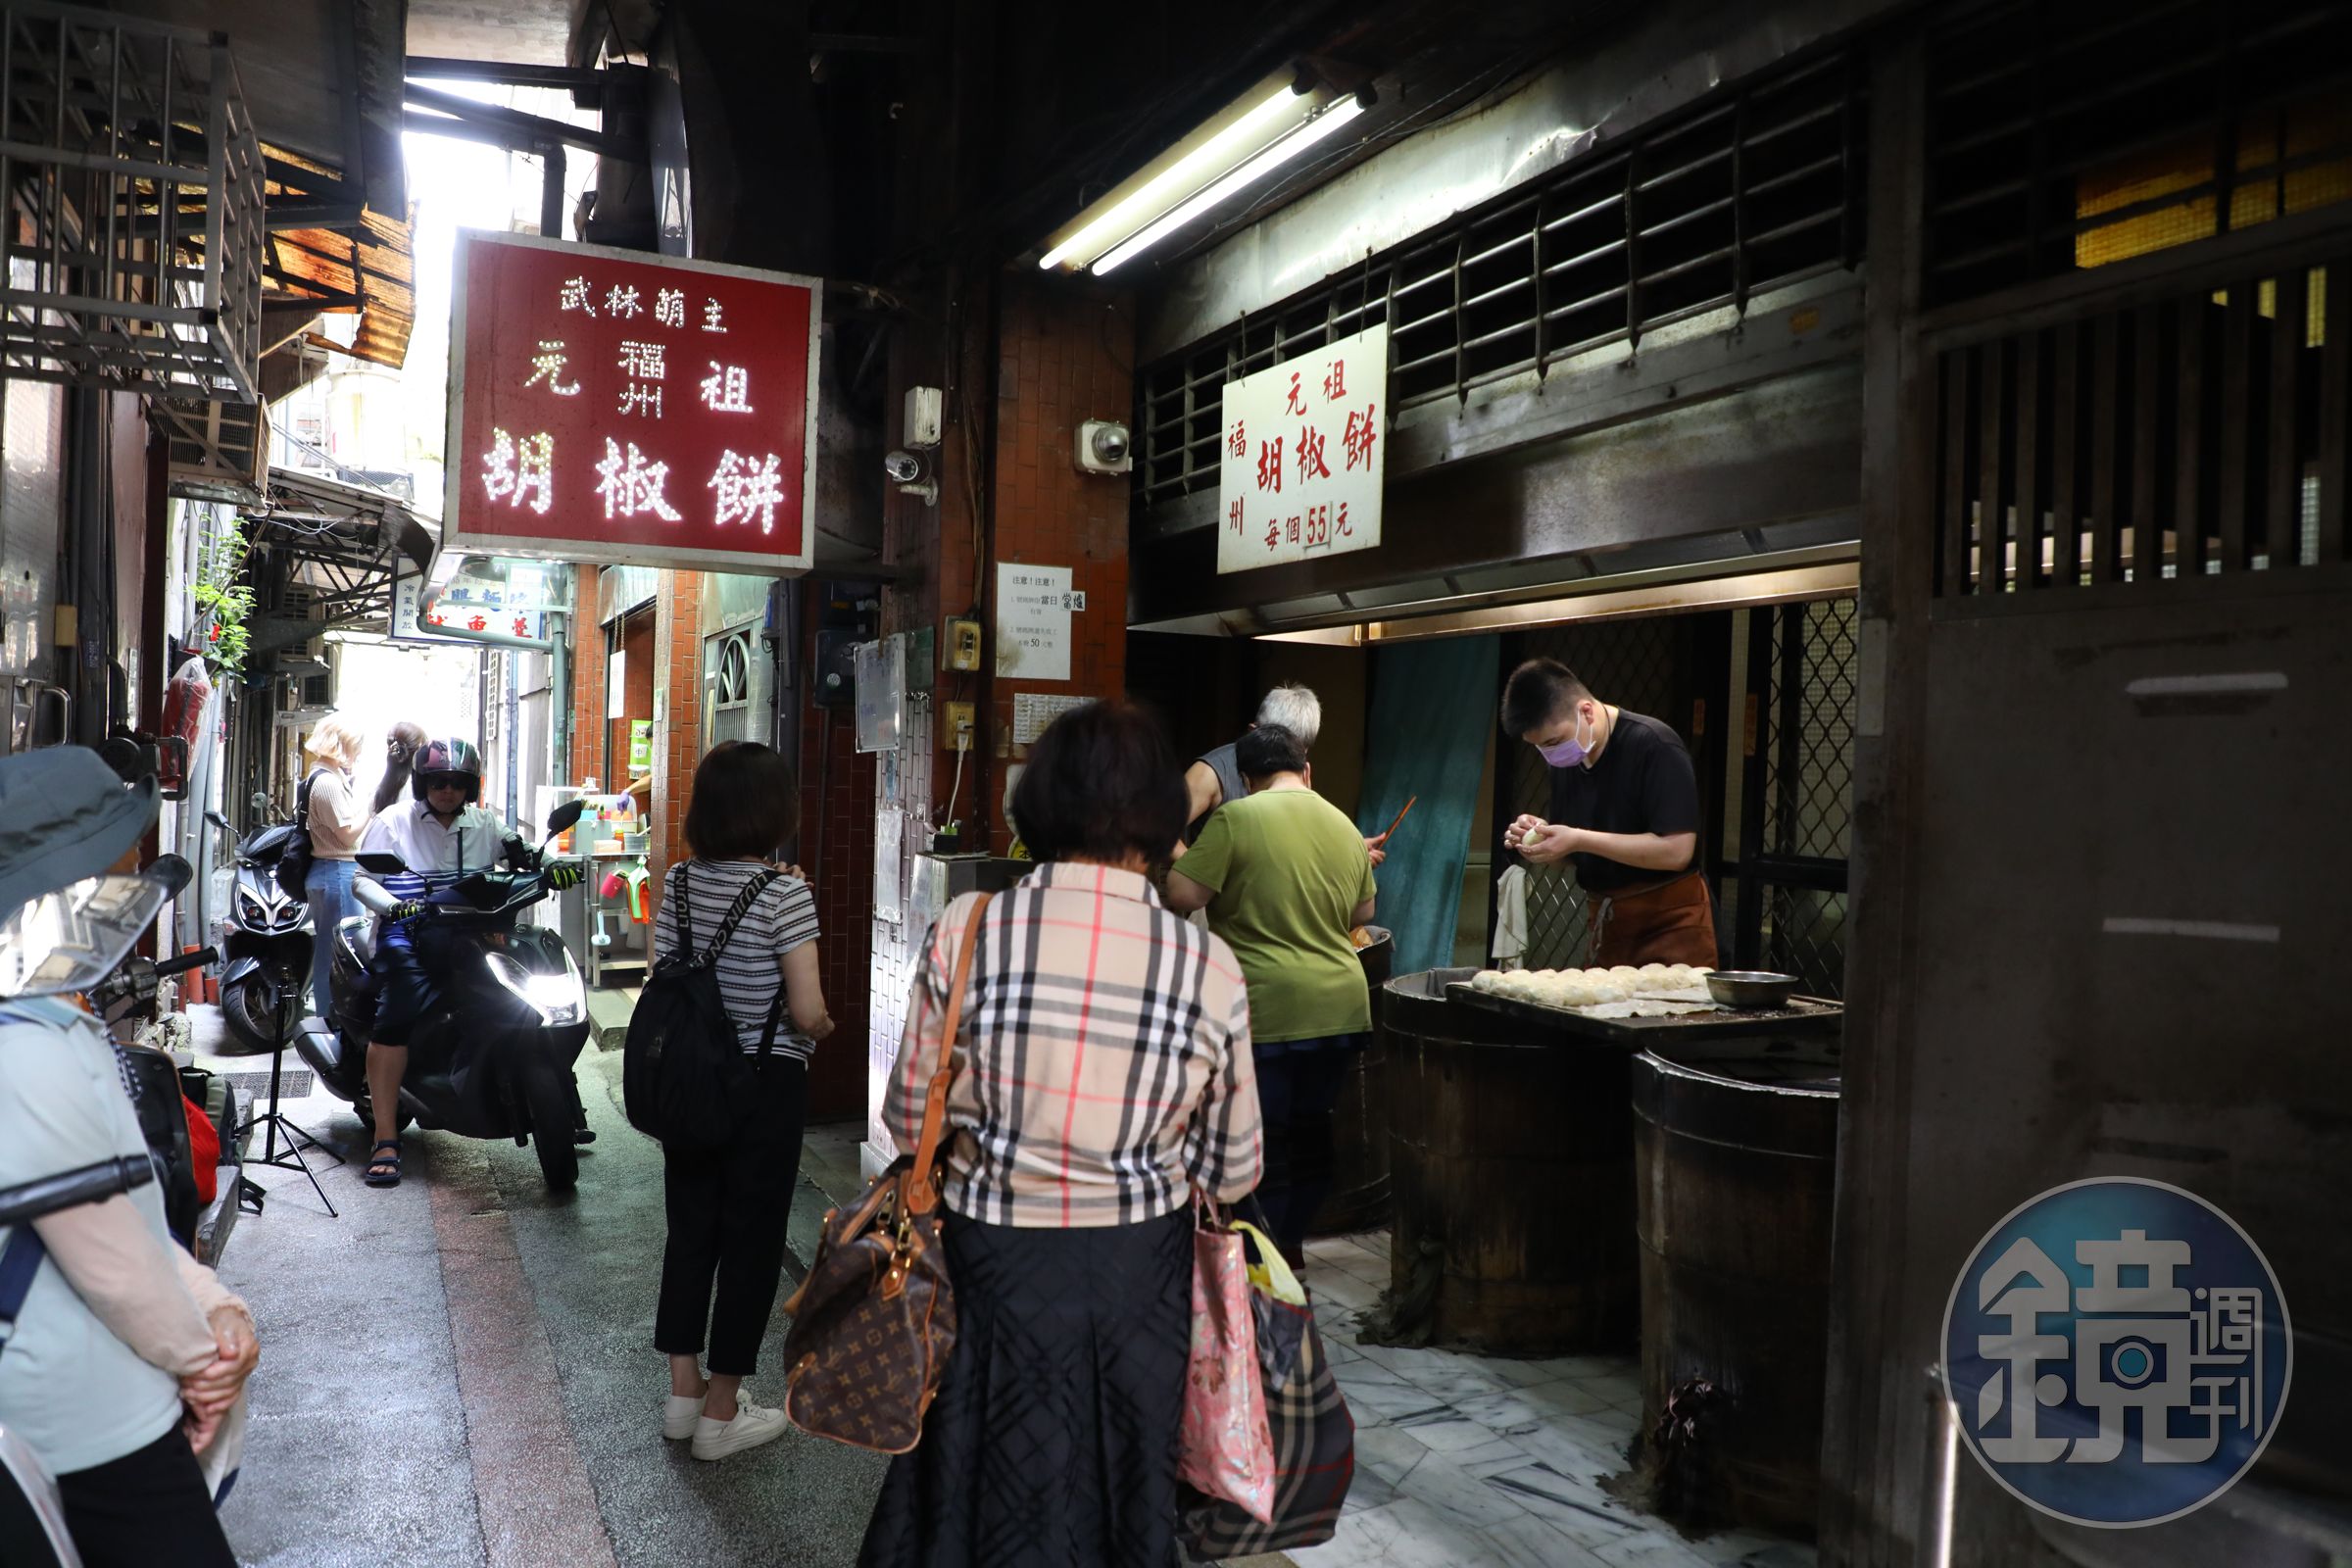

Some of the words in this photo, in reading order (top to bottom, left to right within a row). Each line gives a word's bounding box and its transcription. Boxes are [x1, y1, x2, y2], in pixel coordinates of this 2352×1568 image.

[560, 275, 728, 333] 武林萌主
[617, 339, 667, 418] 福州
[1285, 359, 1348, 416] 元祖
[481, 426, 784, 536] 胡椒餅
[1228, 418, 1248, 537] 福州
[1256, 403, 1377, 494] 胡椒餅
[727, 873, 768, 928] LIUJIN
